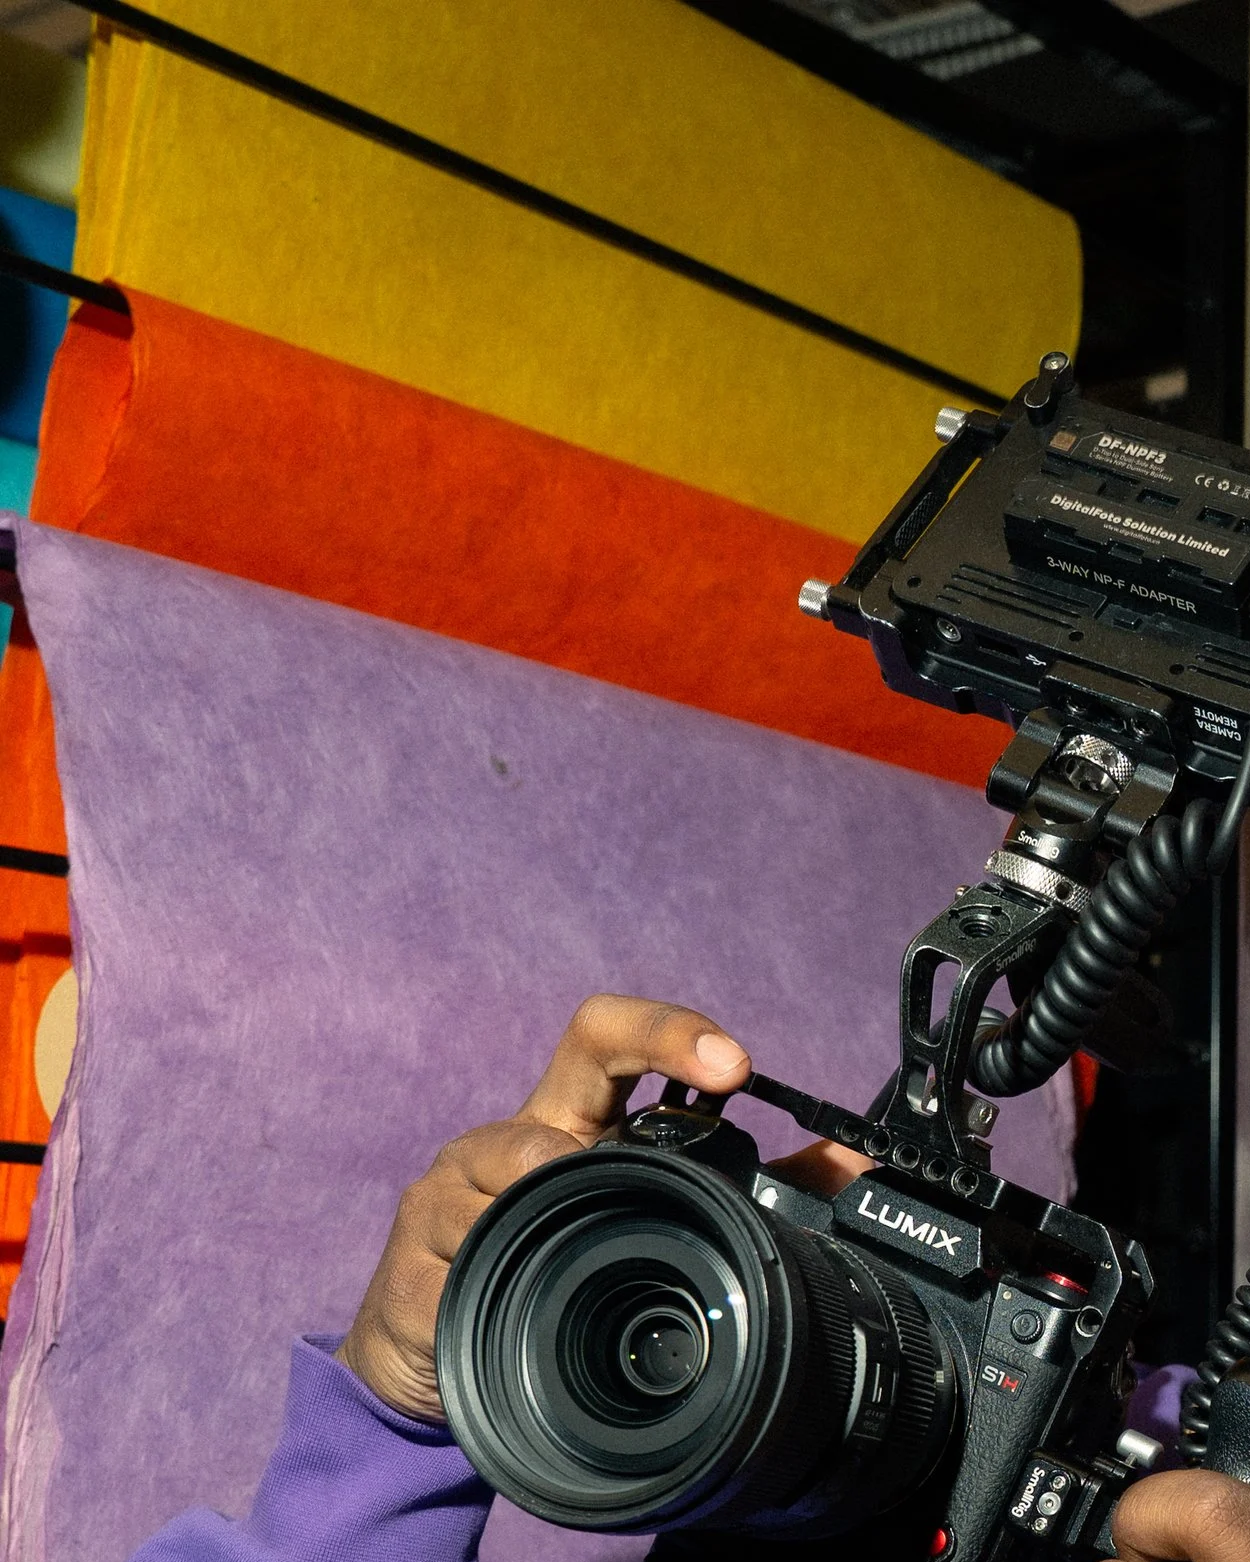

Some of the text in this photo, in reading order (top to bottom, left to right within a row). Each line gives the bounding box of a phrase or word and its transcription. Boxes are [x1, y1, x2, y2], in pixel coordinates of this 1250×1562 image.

[1098, 434, 1167, 464] DF-NPF3
[1150, 470, 1174, 483] Battery
[1050, 494, 1230, 557] DigitalFoto Solution Limited
[1046, 556, 1197, 614] 3-WAY NP-F ADAPTER
[1193, 706, 1238, 729] REMOTE
[1196, 719, 1242, 742] CAMERA
[996, 938, 1037, 972] SmallRig
[857, 1190, 962, 1256] LUMIX
[981, 1364, 1019, 1393] S1H
[1011, 1466, 1046, 1518] SmallRig
